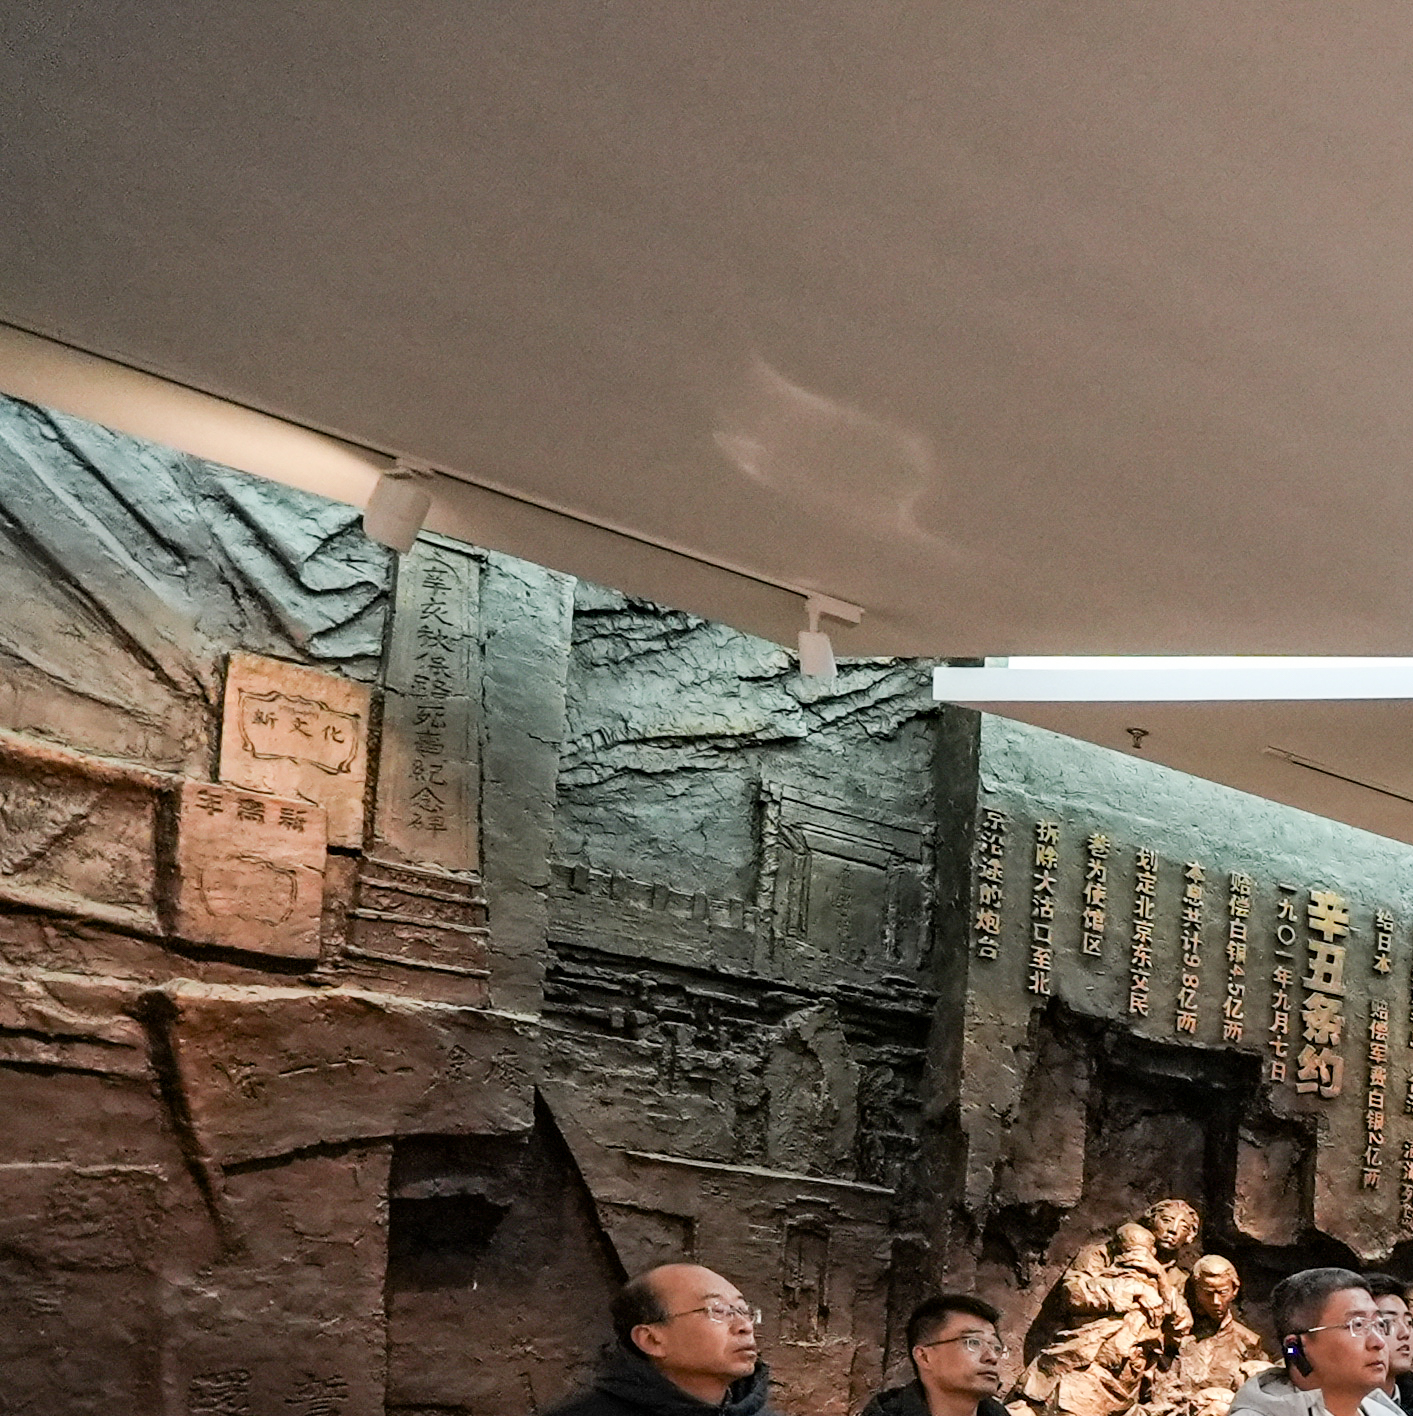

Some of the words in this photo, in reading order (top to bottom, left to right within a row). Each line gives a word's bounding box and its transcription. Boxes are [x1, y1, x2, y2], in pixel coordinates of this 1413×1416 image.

[252, 709, 345, 744] 新文化
[975, 807, 1007, 959] 京沿途的炮台
[1029, 818, 1060, 996] 拆除大沽口至北
[1083, 832, 1110, 957] 巷为使馆区
[1129, 846, 1159, 1017] 划定北京东交民
[1176, 860, 1207, 1034] 本息共计9.8亿两
[1222, 869, 1252, 1044] 赔偿白银4.5亿两
[1373, 907, 1394, 975] 给日本
[1296, 889, 1350, 1099] 辛丑条约
